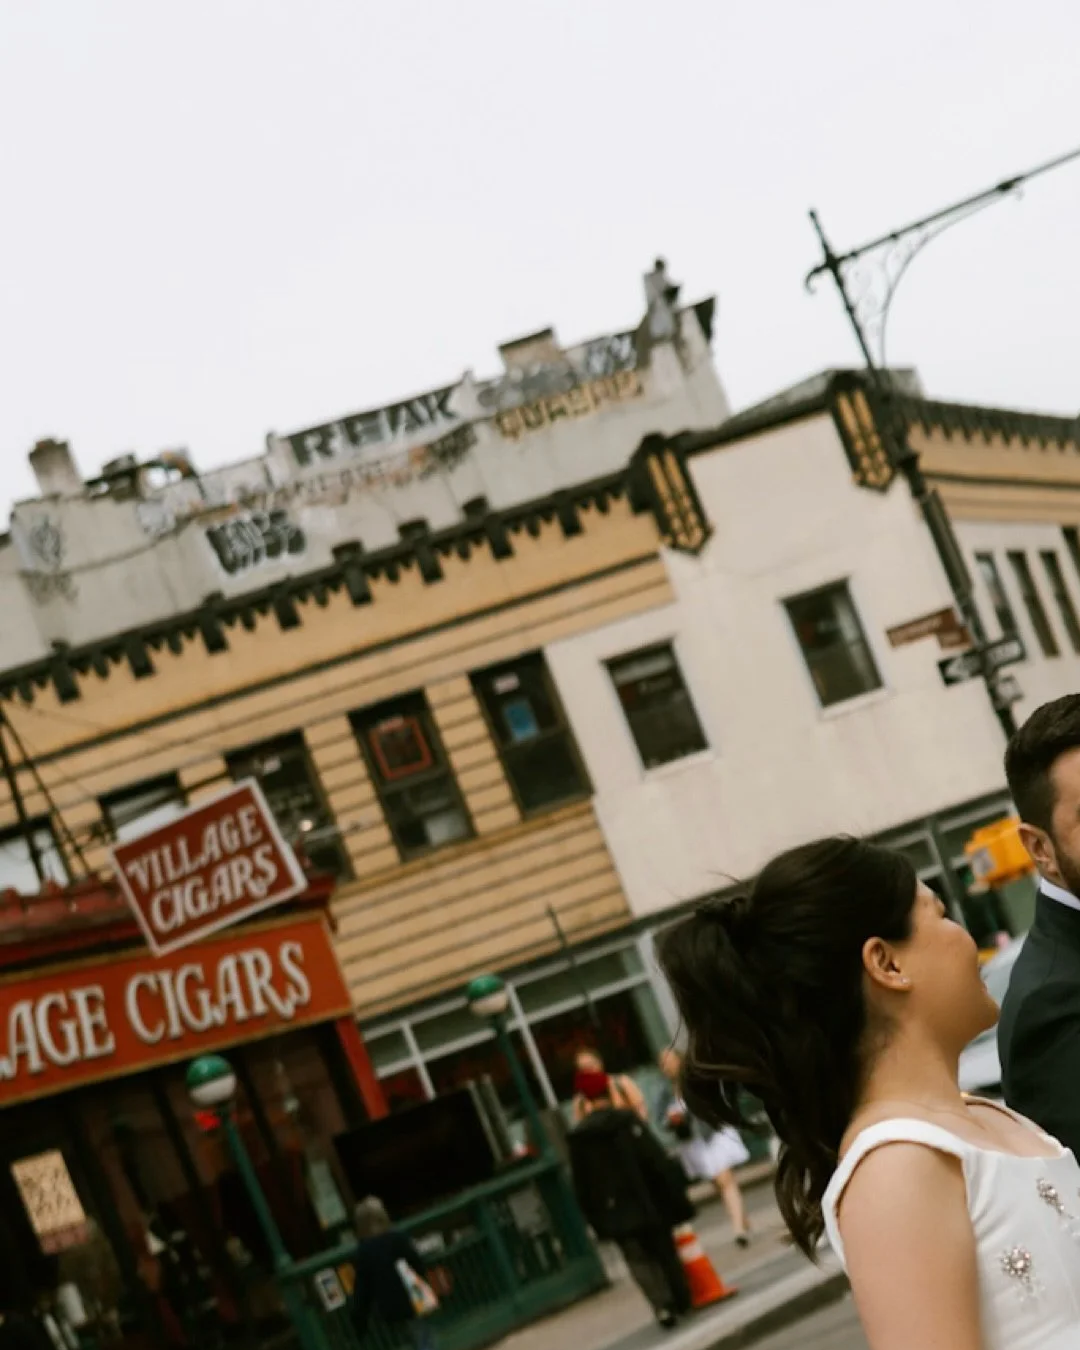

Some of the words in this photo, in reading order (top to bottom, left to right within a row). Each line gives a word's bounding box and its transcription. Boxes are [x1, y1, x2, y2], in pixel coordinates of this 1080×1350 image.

[127, 806, 263, 894] VILLAGE
[151, 844, 277, 932] CIGARS
[126, 941, 311, 1043] CIGARS
